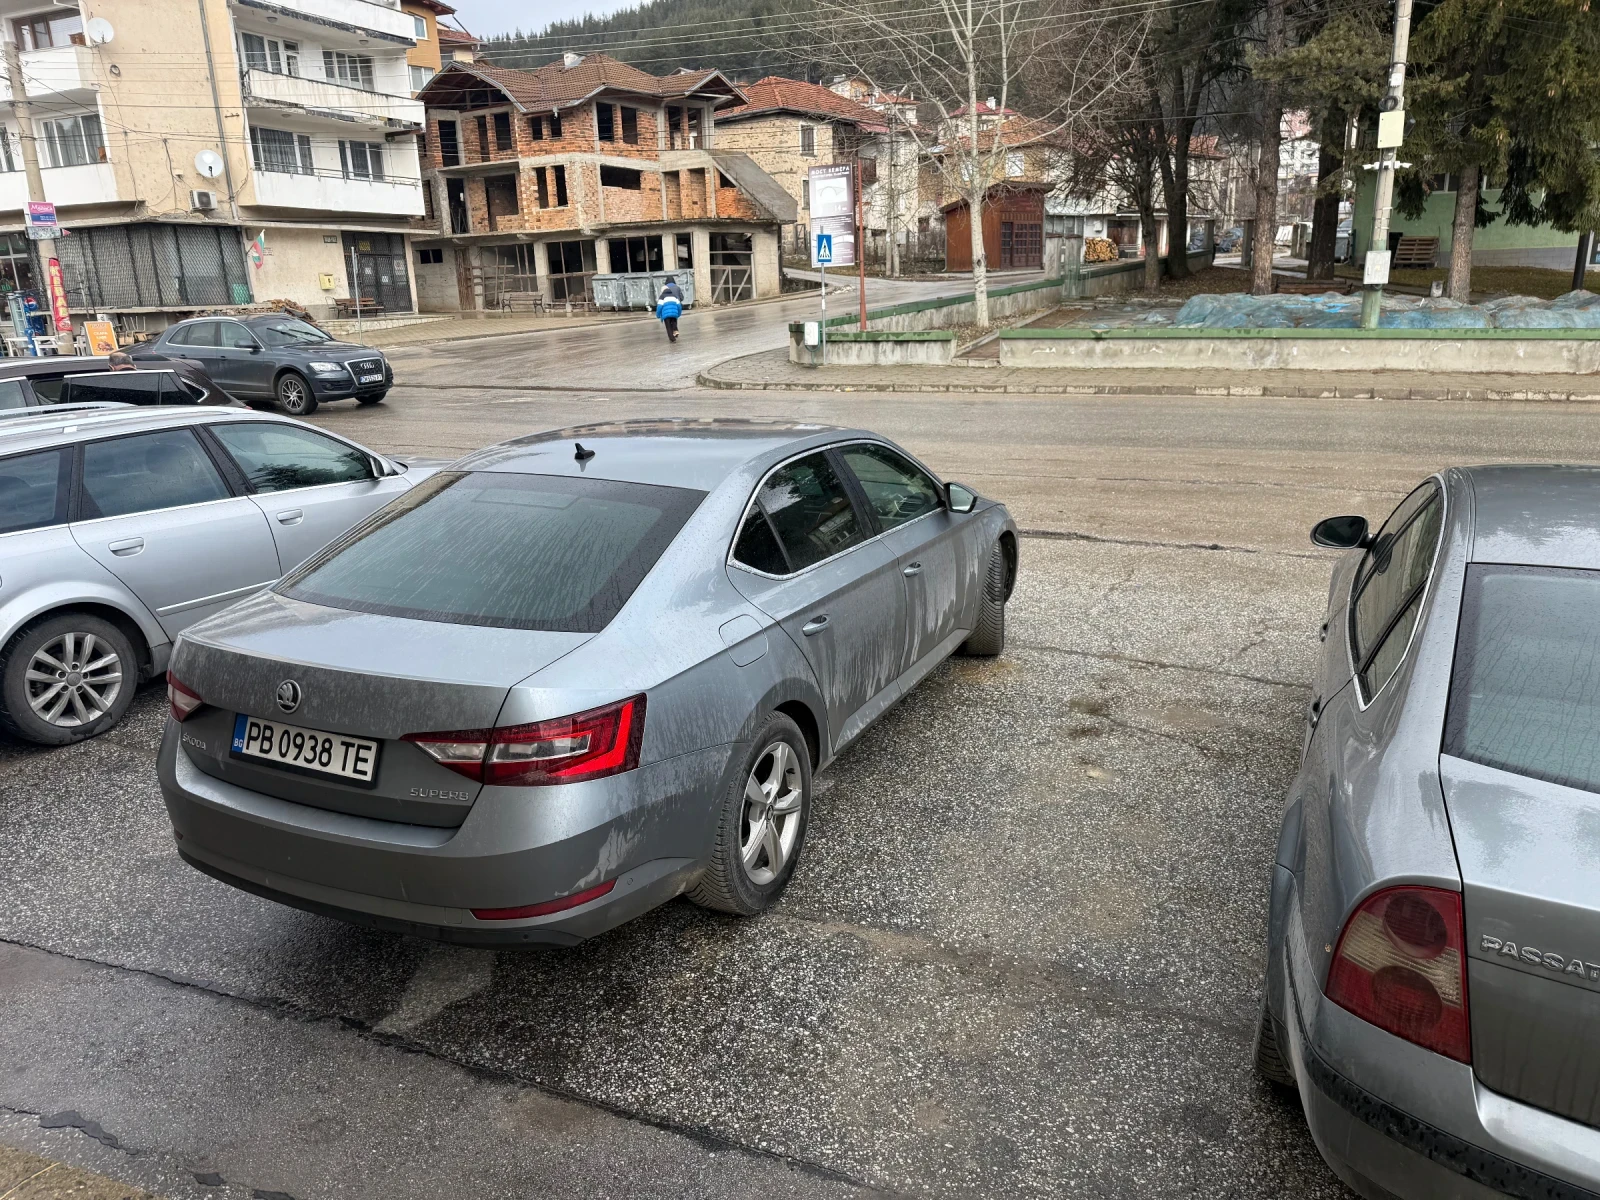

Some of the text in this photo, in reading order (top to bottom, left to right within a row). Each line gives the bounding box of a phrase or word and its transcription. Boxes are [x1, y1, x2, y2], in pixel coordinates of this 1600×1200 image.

[233, 737, 243, 748] BG
[245, 721, 373, 776] PB 0938 TE
[409, 787, 470, 801] SUPERB
[1480, 933, 1600, 982] PASSAT
